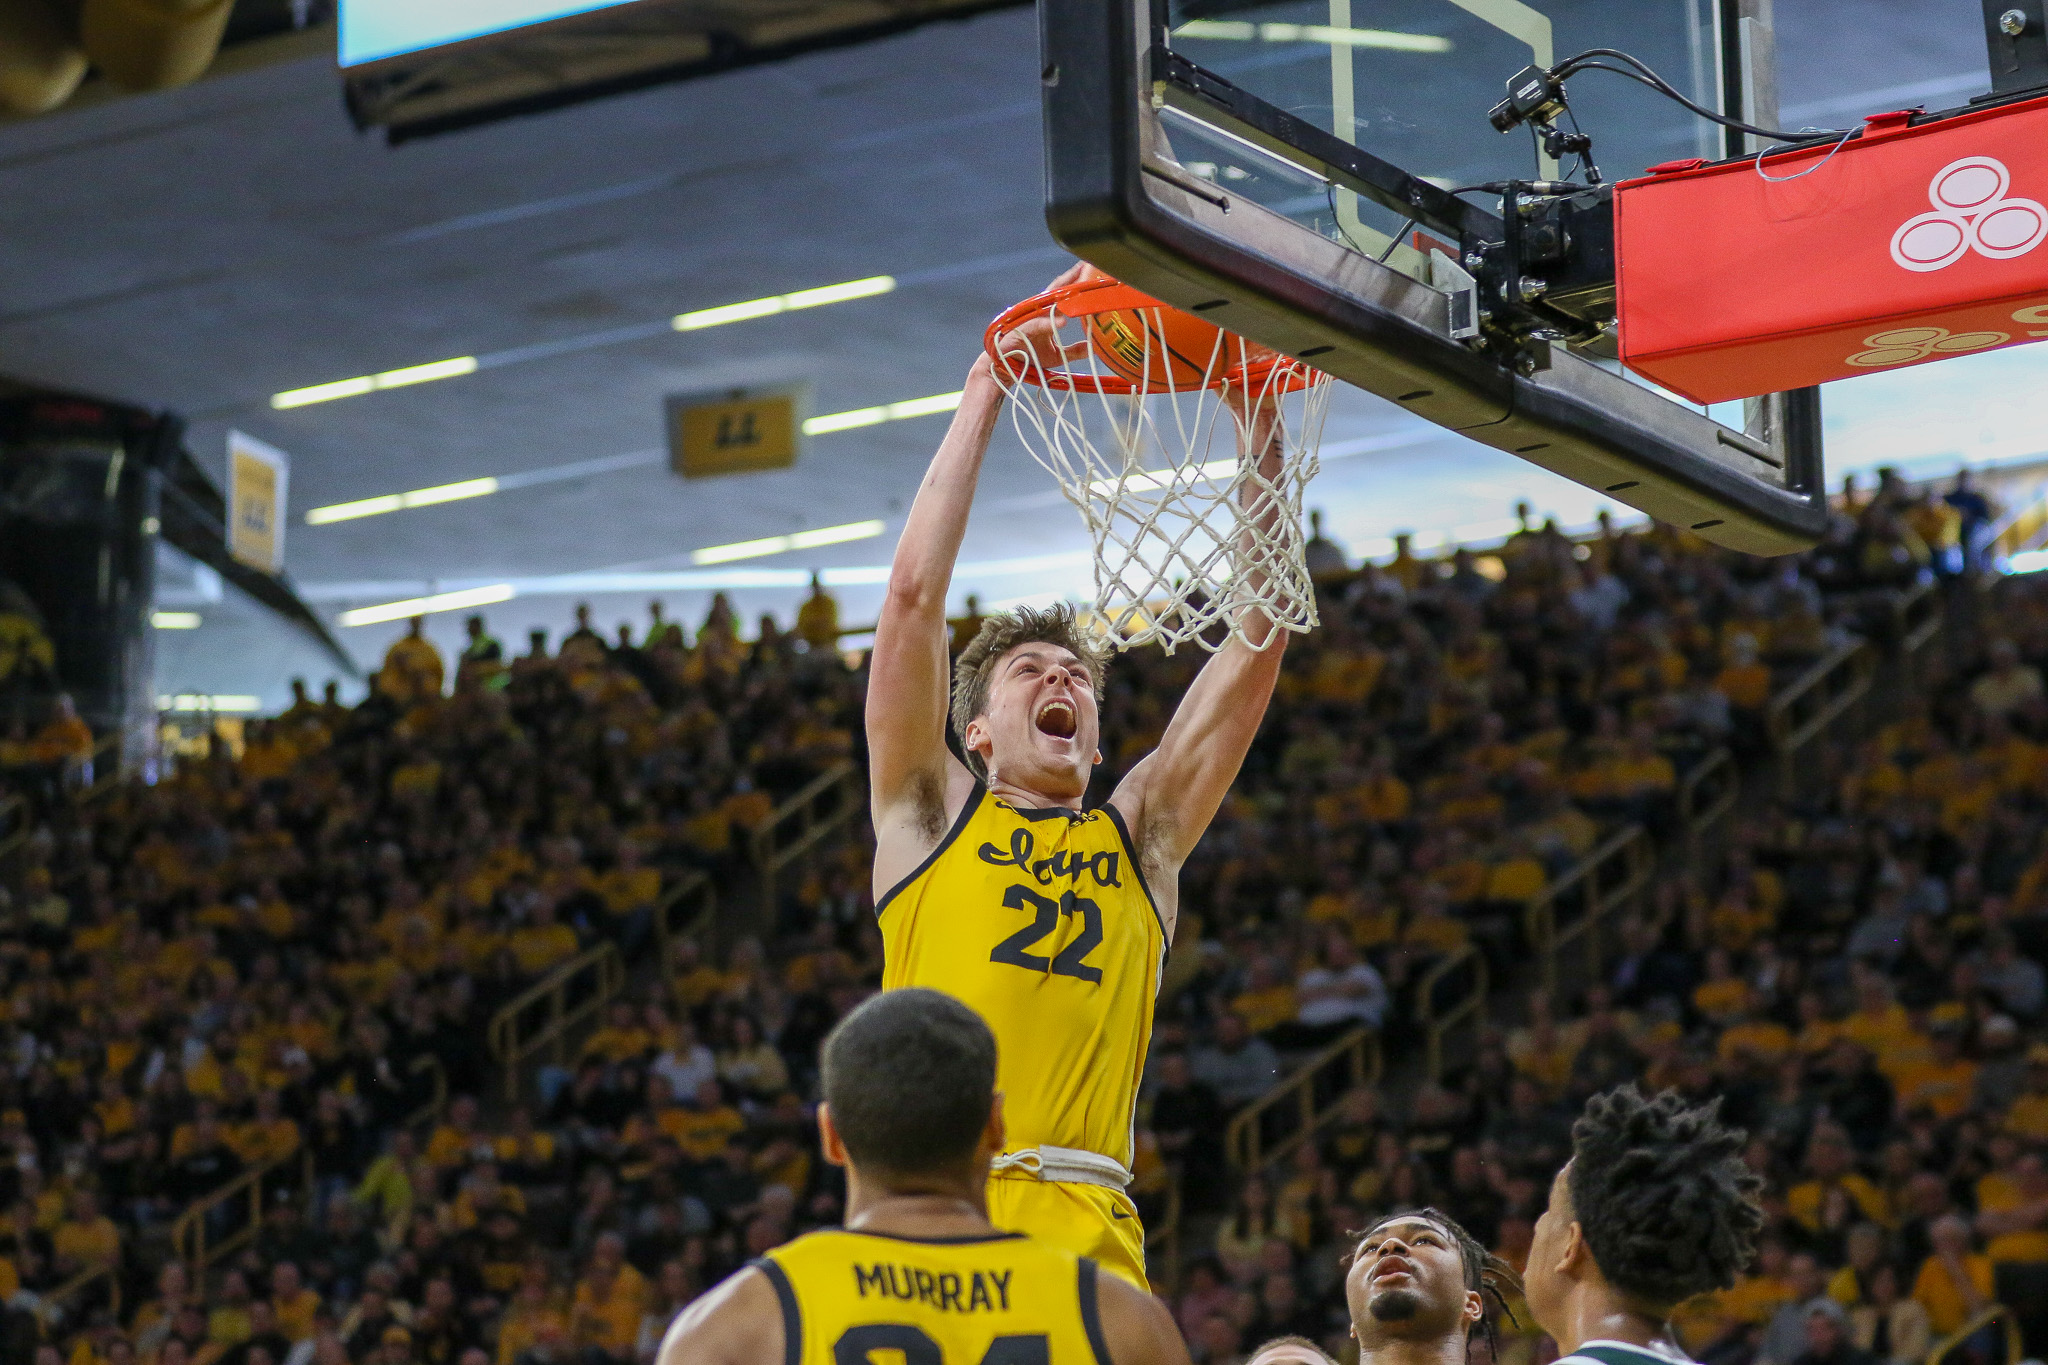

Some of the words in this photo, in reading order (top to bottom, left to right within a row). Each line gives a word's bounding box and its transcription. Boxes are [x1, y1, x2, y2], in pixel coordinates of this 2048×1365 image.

[978, 828, 1122, 888] Iowa
[990, 883, 1103, 986] 22
[853, 1263, 1012, 1313] MURRAY
